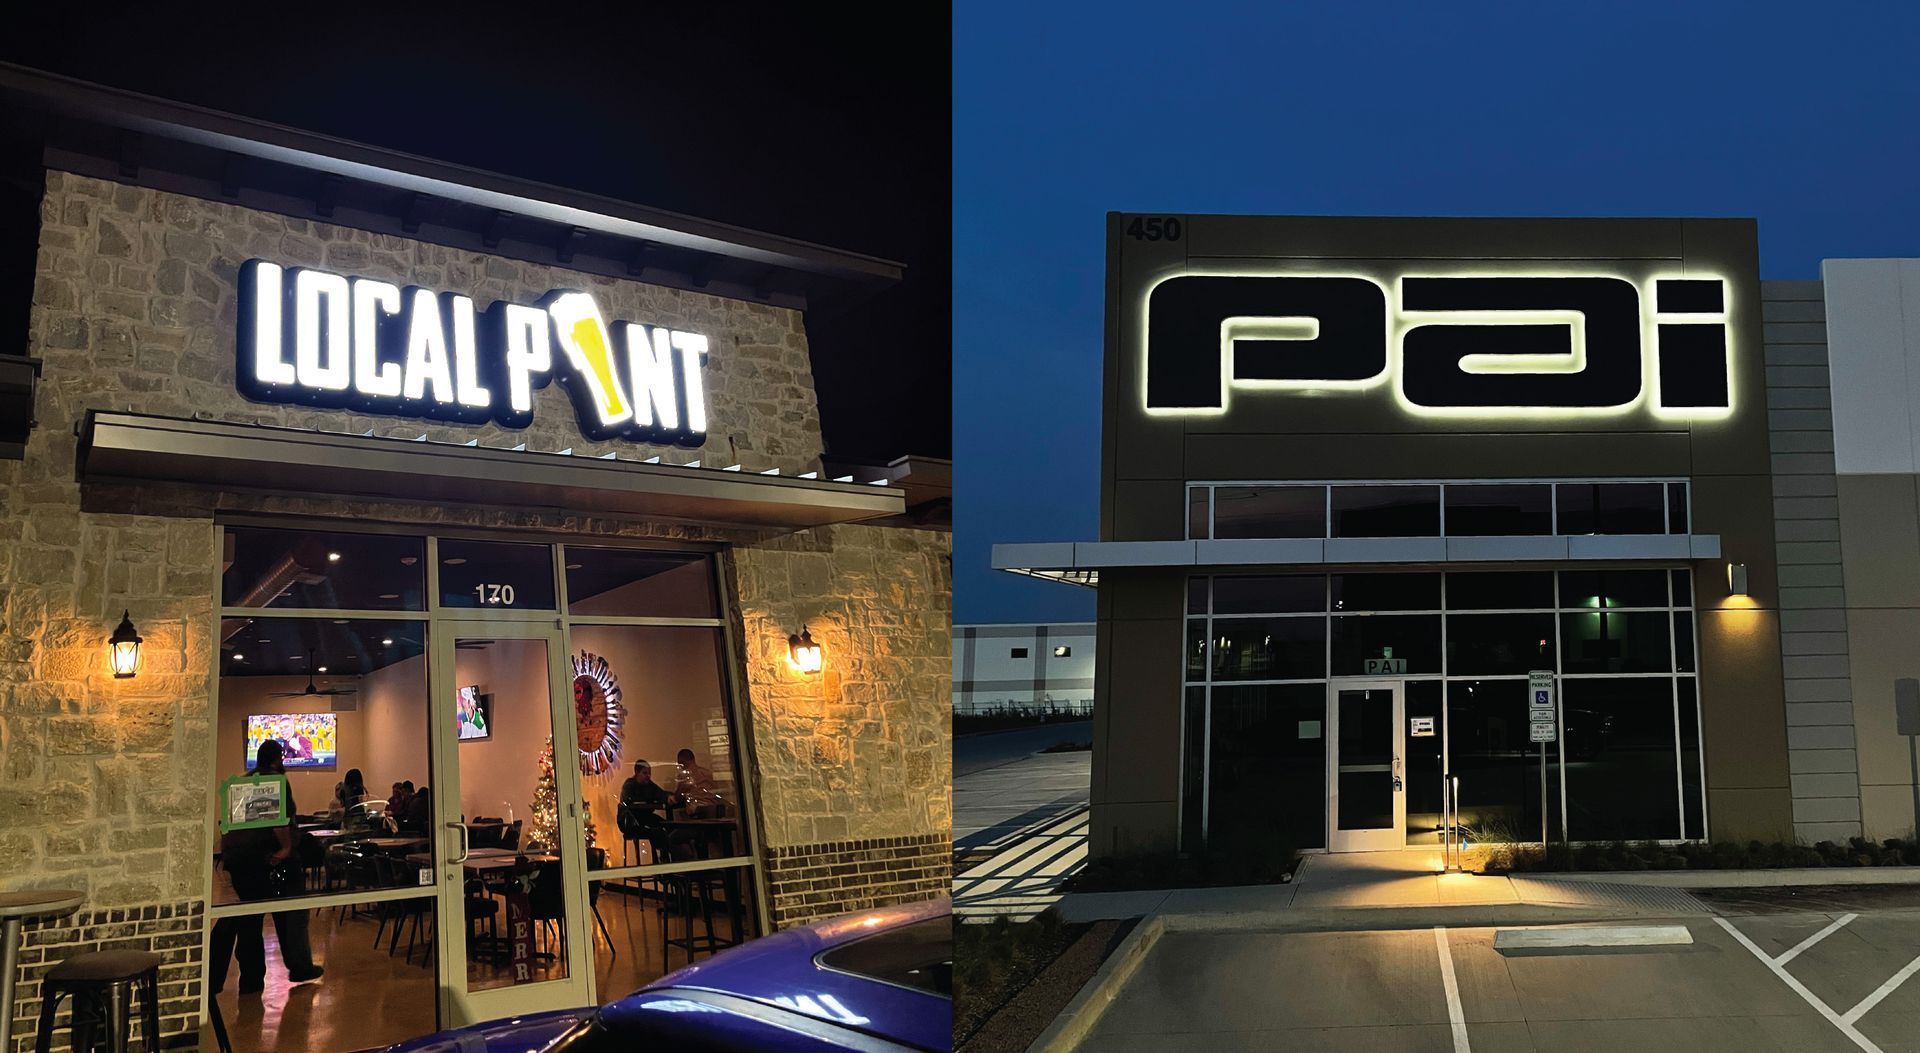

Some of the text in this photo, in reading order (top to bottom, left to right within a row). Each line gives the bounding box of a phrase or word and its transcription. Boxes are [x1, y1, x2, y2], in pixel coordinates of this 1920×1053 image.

[1127, 217, 1181, 241] 450
[256, 262, 490, 407] LOCAL
[475, 583, 515, 605] 170
[1368, 660, 1400, 673] PAI
